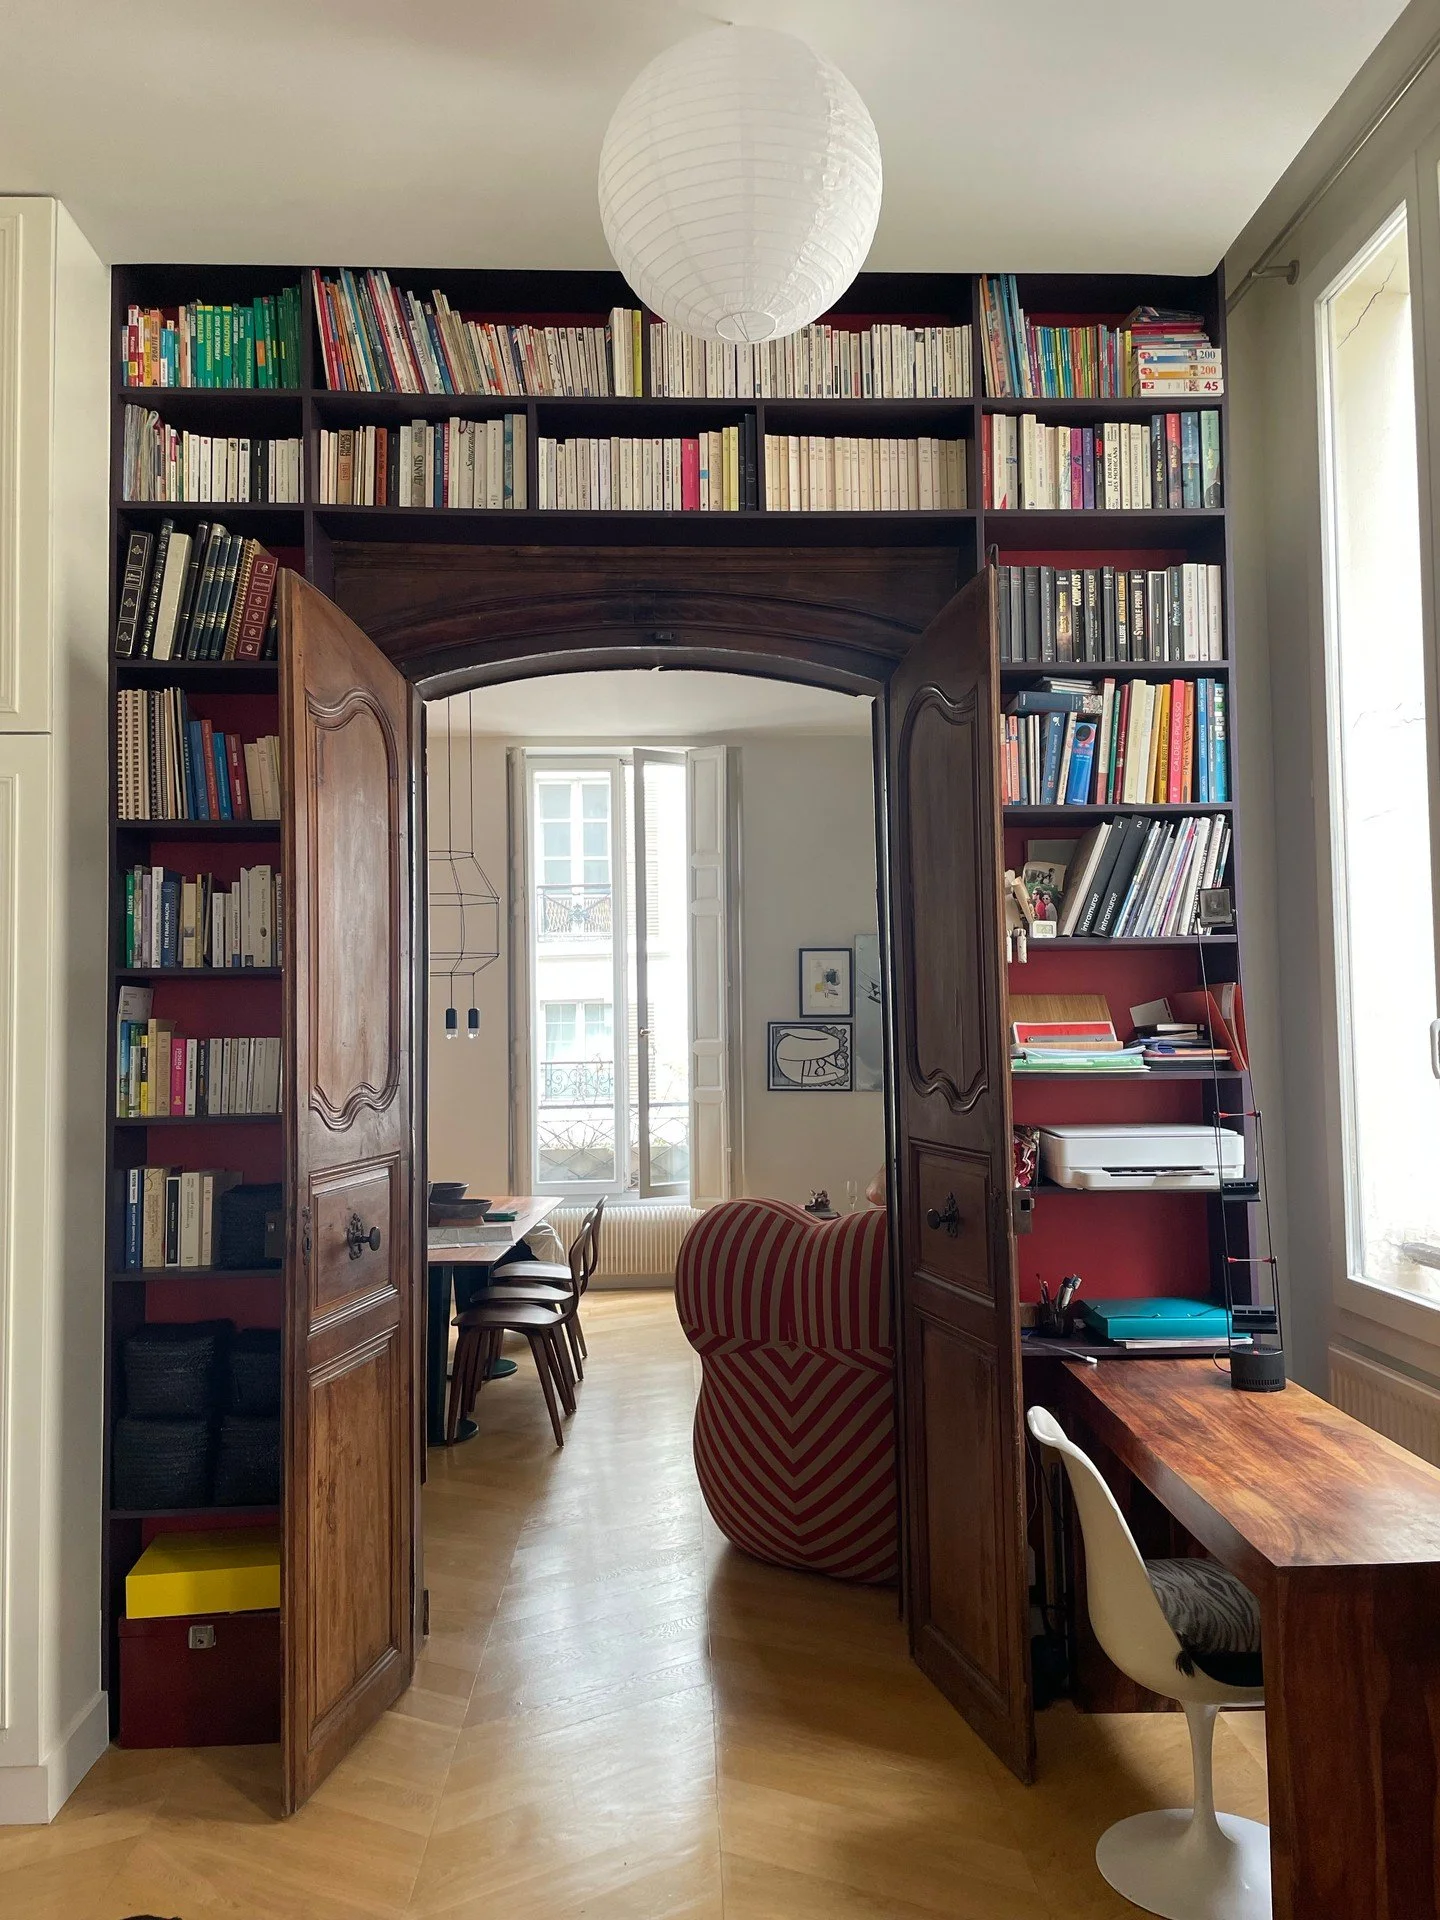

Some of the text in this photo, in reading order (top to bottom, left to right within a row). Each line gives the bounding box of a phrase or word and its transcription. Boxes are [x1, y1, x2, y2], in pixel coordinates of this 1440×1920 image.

[415, 340, 427, 366] NATURE
[1201, 366, 1216, 374] 200
[1204, 382, 1218, 390] 45
[414, 455, 424, 486] ATLANTIS
[1072, 574, 1081, 606] COMPLOTS
[1134, 590, 1142, 608] PERDU
[1134, 609, 1144, 636] SYMBOLE
[1172, 702, 1182, 772] CALDER-PICASSO
[1081, 893, 1099, 932] intramuros
[1101, 892, 1118, 932] intramuros
